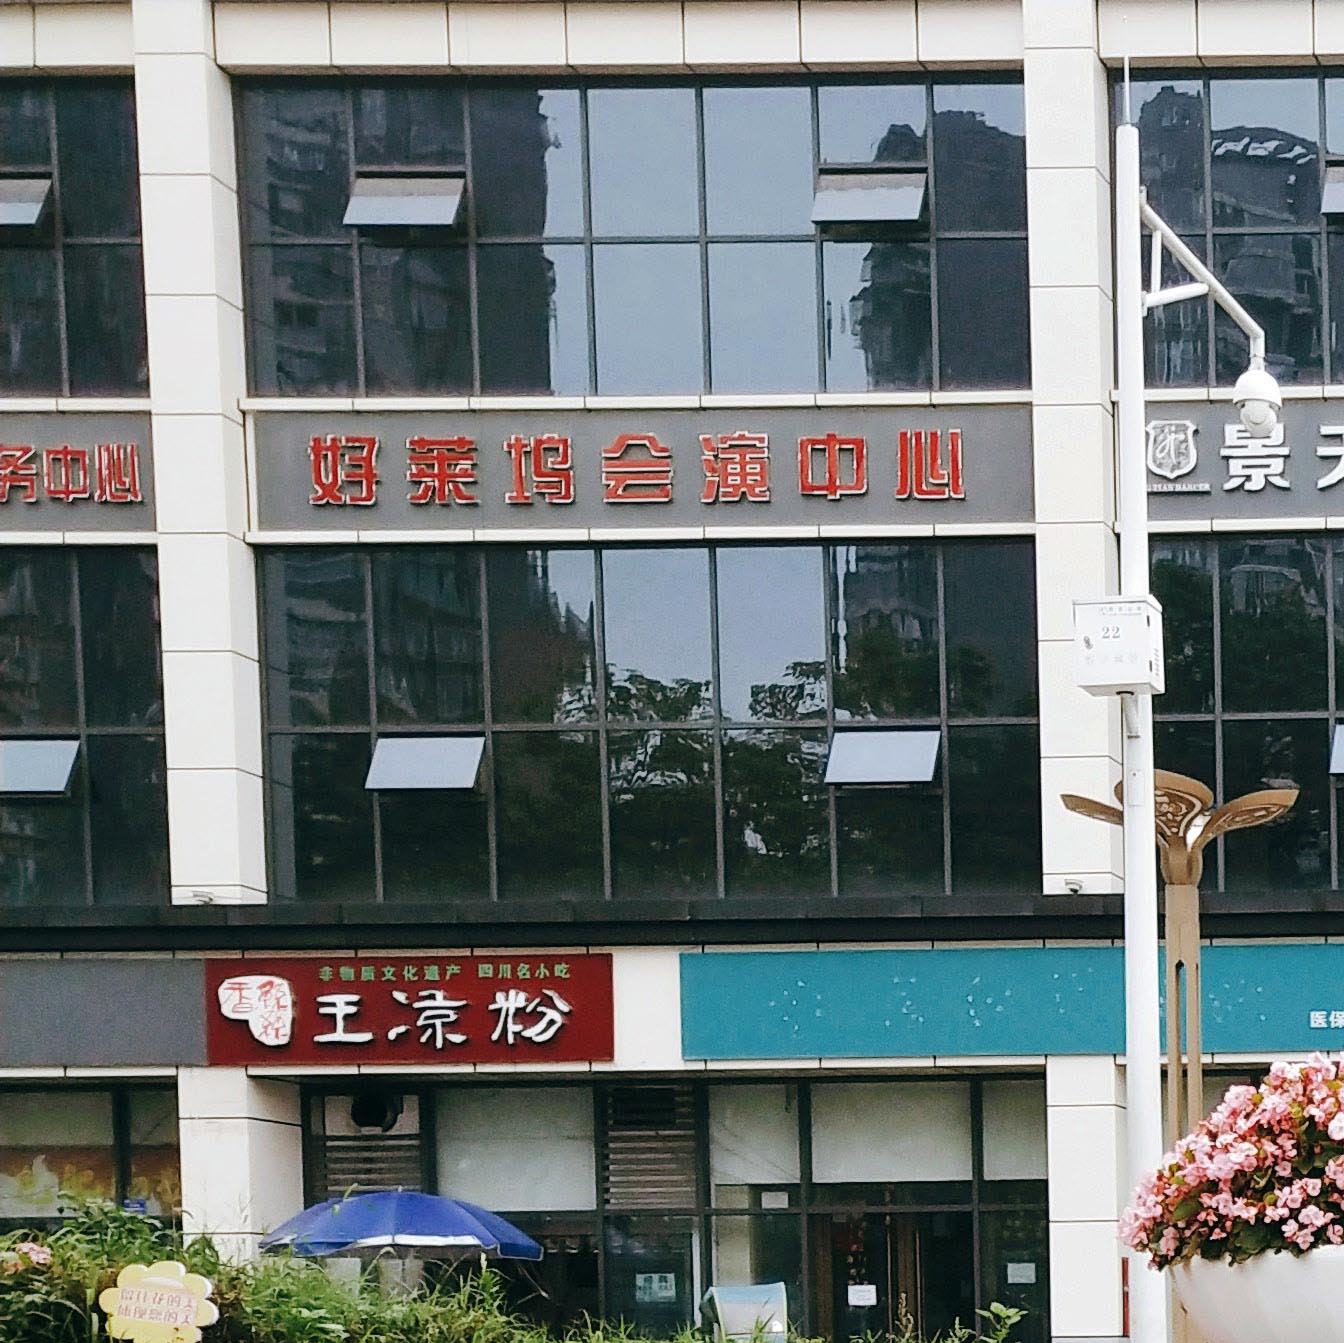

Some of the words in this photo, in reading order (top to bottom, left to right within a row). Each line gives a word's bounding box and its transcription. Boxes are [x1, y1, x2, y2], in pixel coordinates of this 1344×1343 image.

[308, 428, 966, 505] 好莱坞会演中心
[1102, 626, 1120, 639] 22
